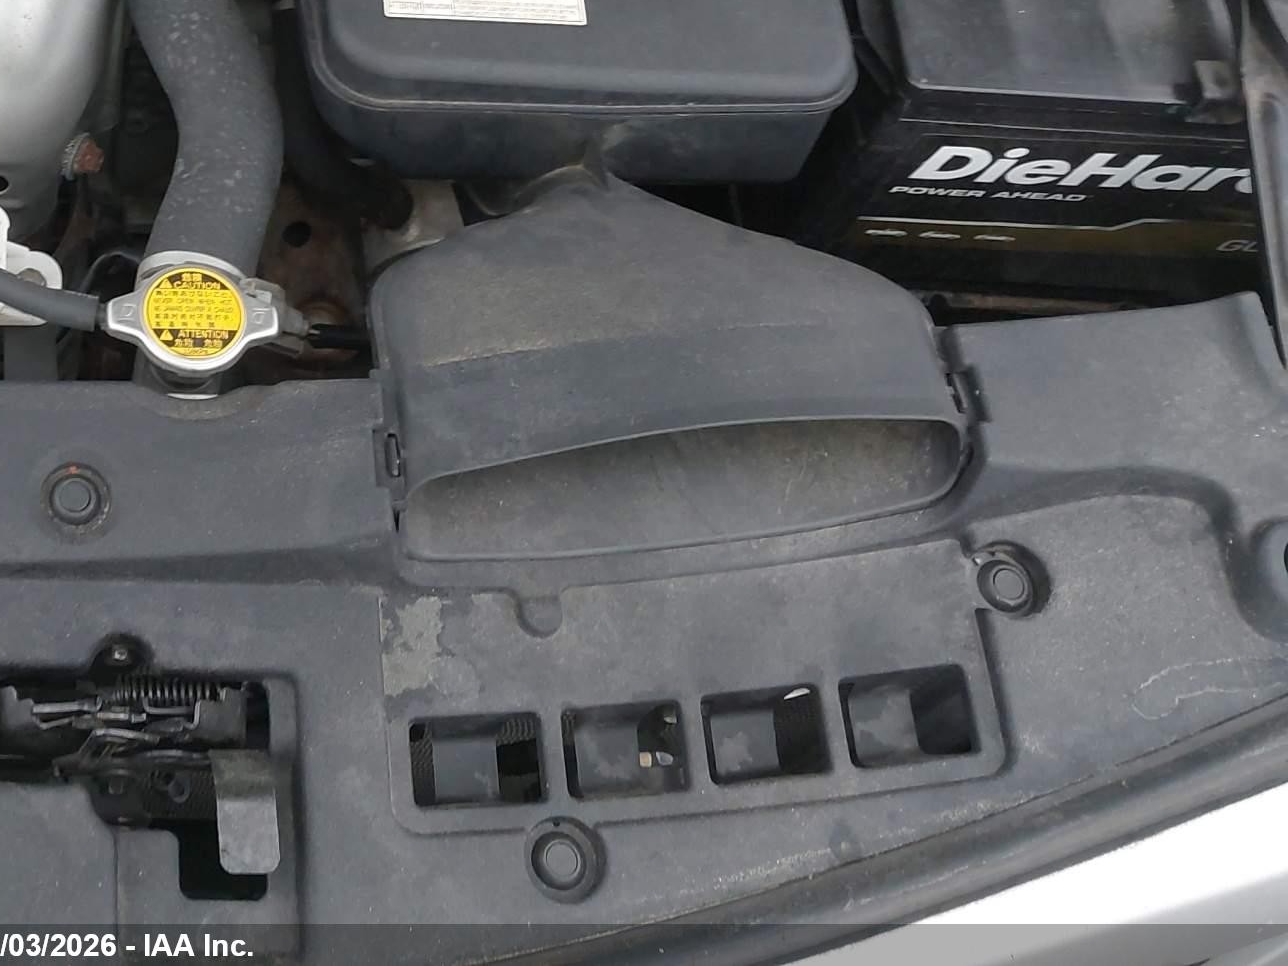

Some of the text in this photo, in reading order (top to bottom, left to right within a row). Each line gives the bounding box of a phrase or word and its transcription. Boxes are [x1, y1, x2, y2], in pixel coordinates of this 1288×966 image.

[888, 185, 1089, 202] POWER AHEAD
[174, 280, 221, 290] CAUTION
[178, 329, 229, 339] ATTENTION
